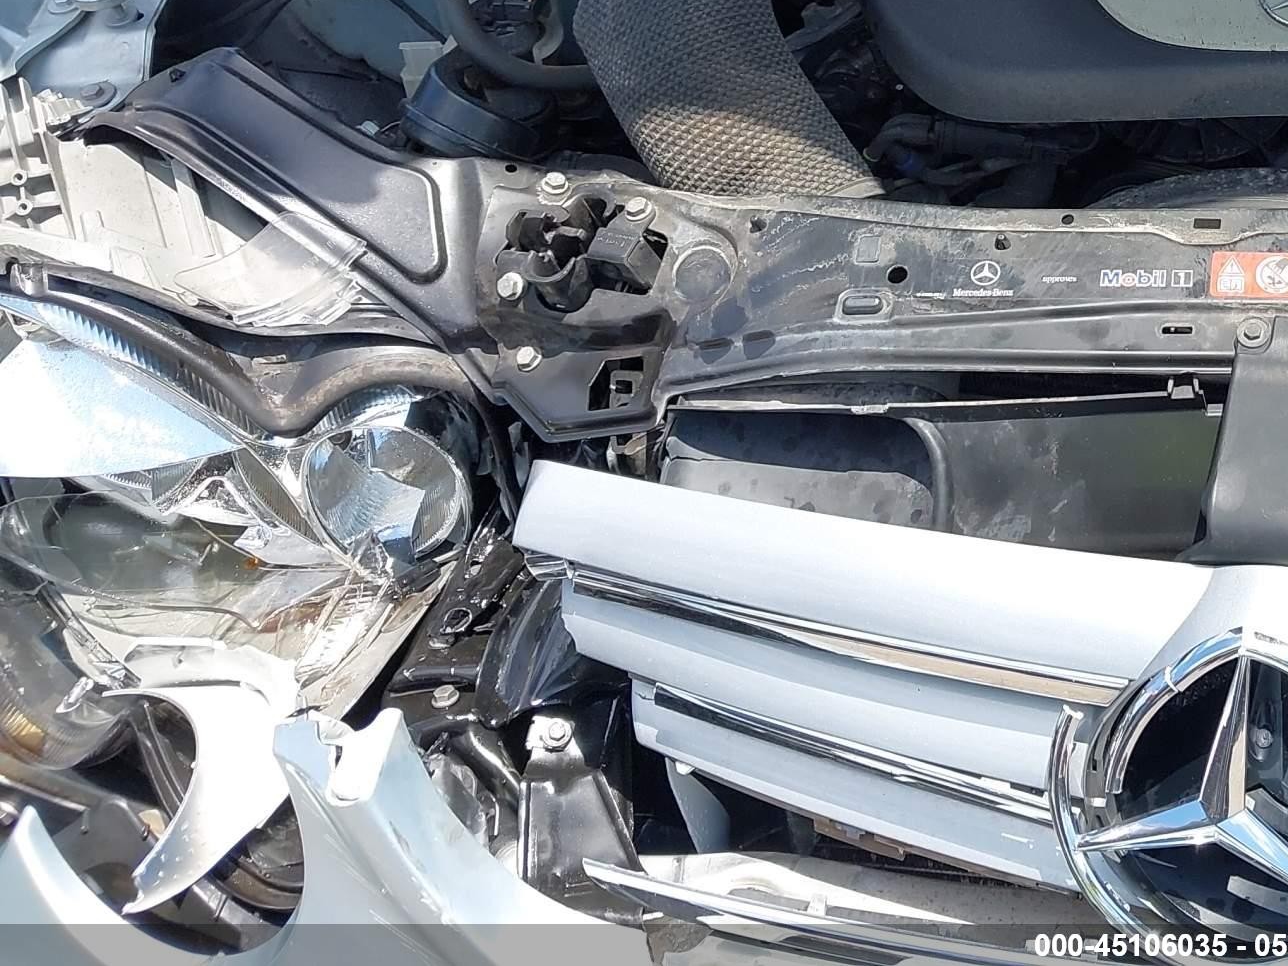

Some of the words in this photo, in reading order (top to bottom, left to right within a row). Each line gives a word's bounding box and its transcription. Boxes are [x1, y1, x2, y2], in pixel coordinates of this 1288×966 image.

[953, 288, 1014, 298] Mercedes-Benz
[1042, 275, 1078, 284] approves
[1100, 269, 1167, 287] Mobil
[1171, 269, 1193, 287] 1
